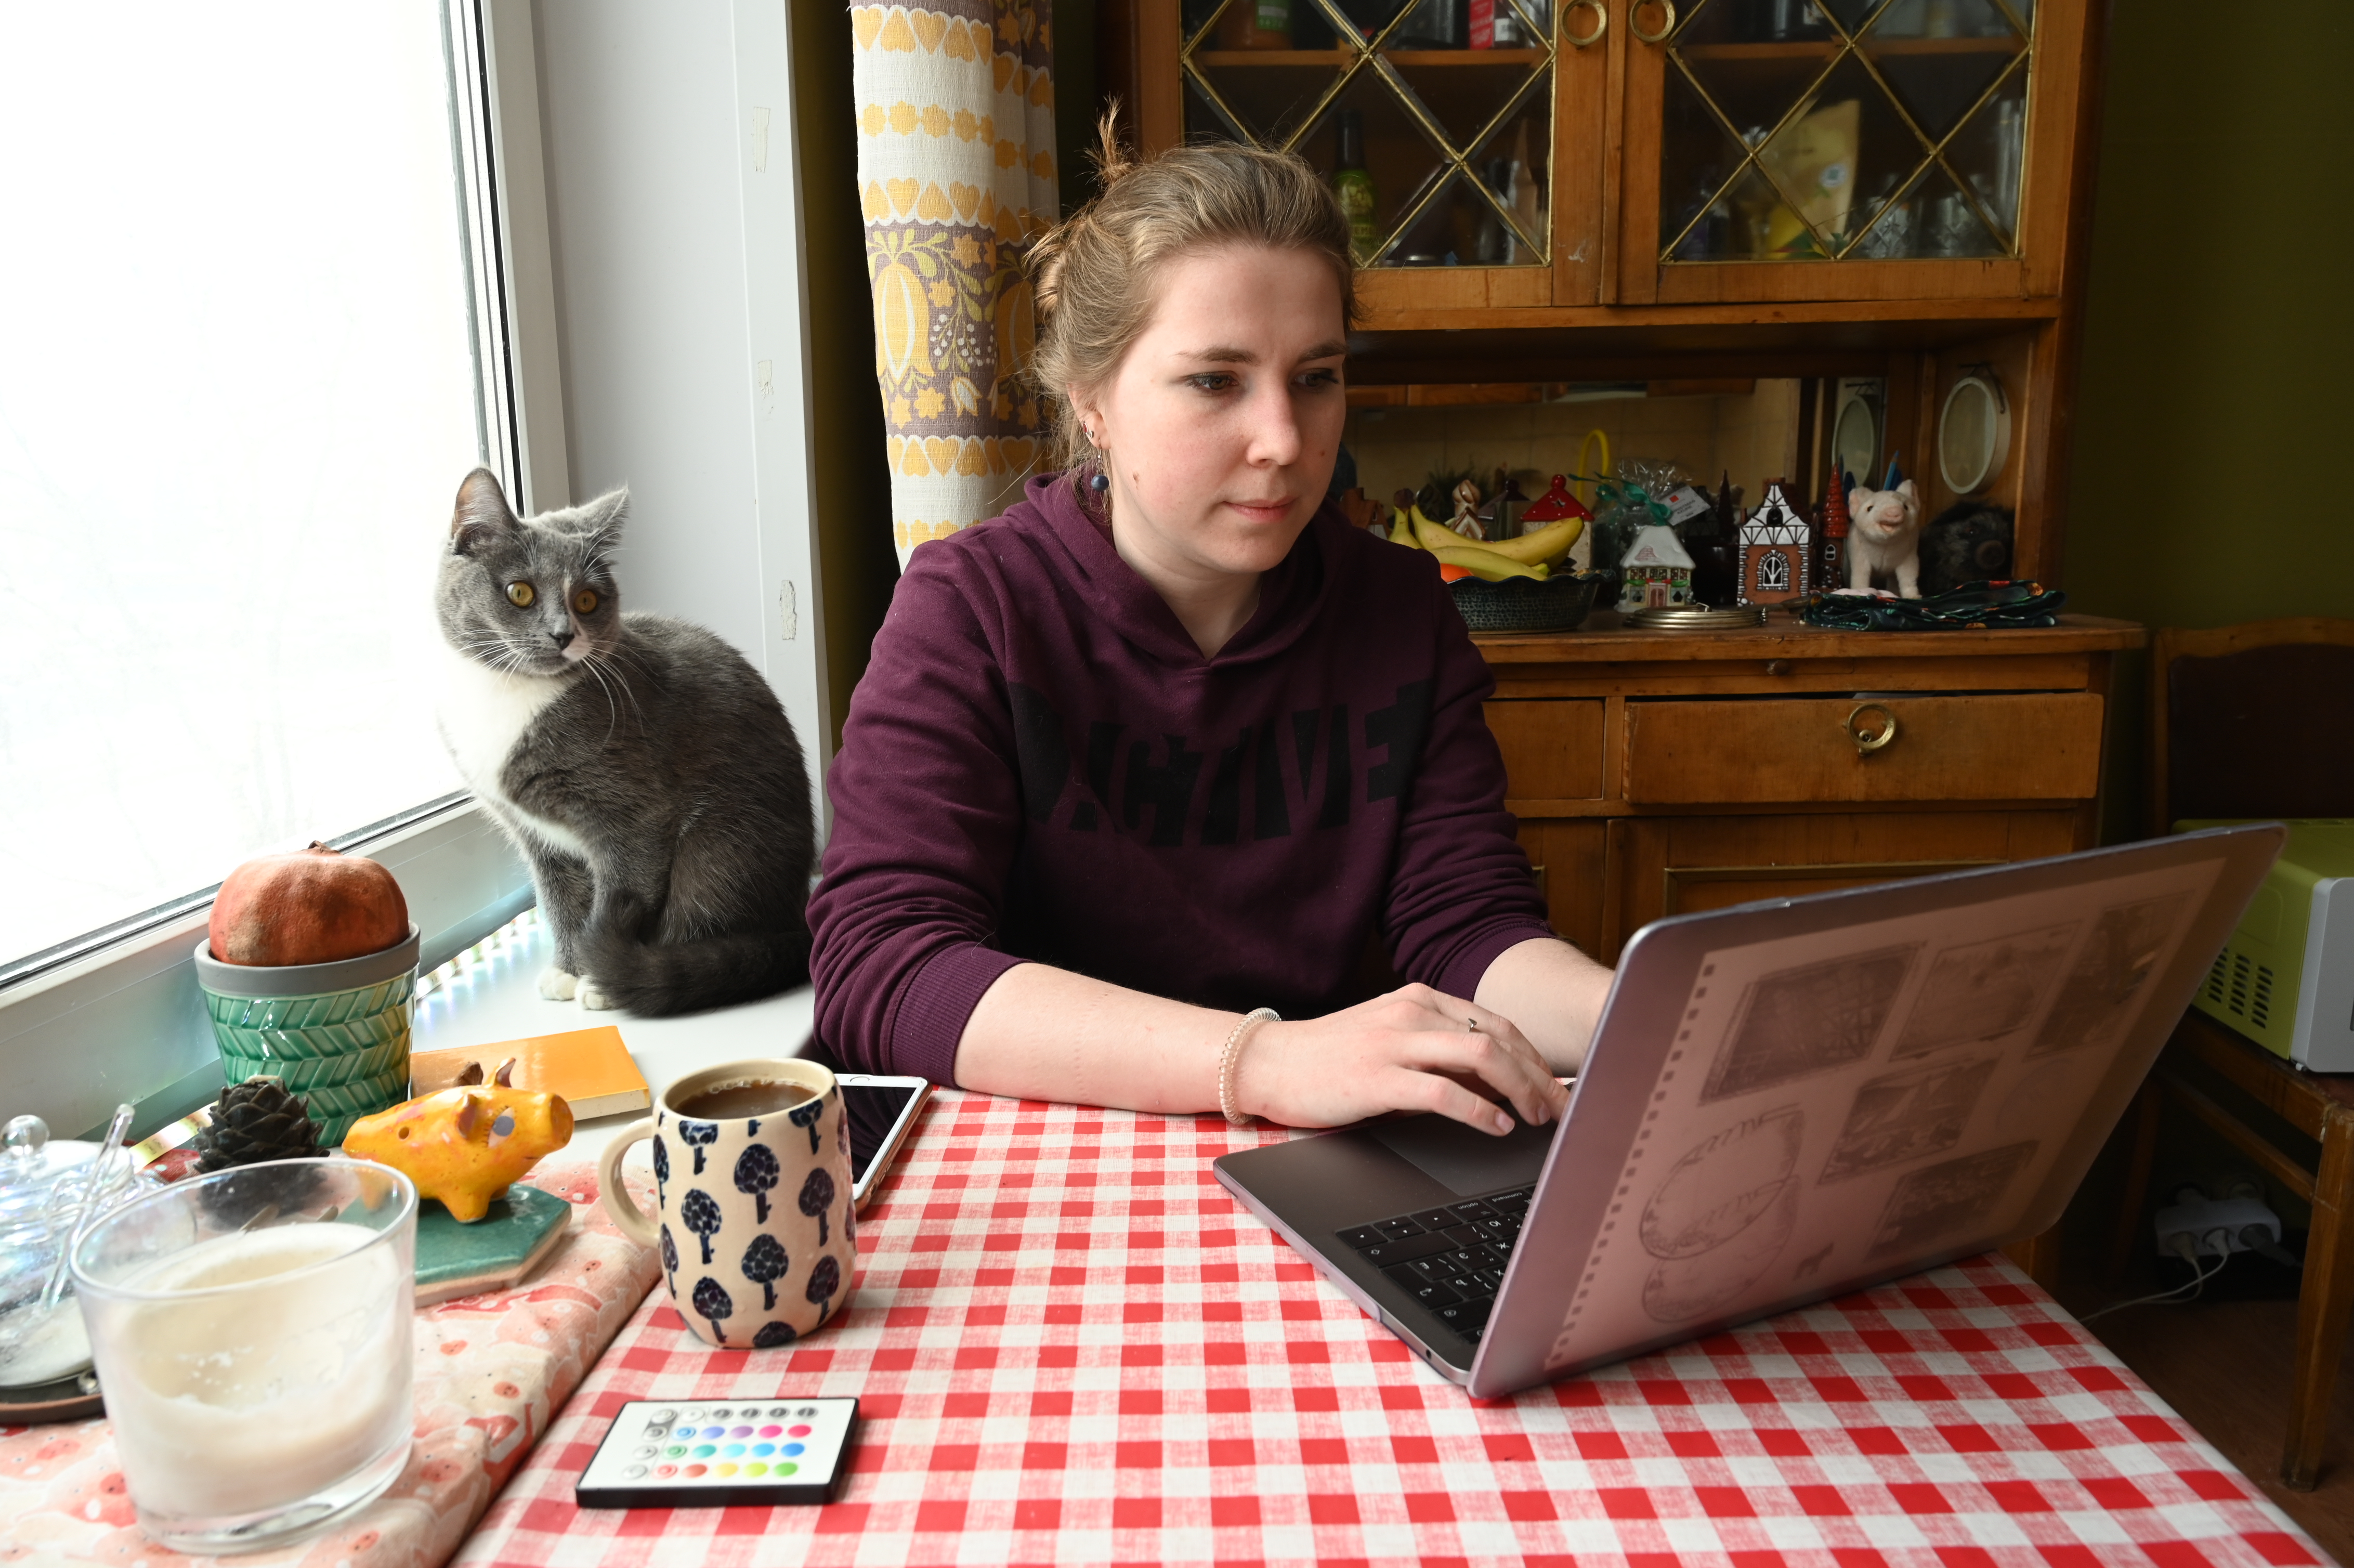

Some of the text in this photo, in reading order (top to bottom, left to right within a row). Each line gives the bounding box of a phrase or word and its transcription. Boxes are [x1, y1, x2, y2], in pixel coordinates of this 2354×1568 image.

[1032, 682, 1410, 846] ACTIVE
[1492, 1192, 1522, 1203] command
[1457, 1201, 1479, 1210] option
